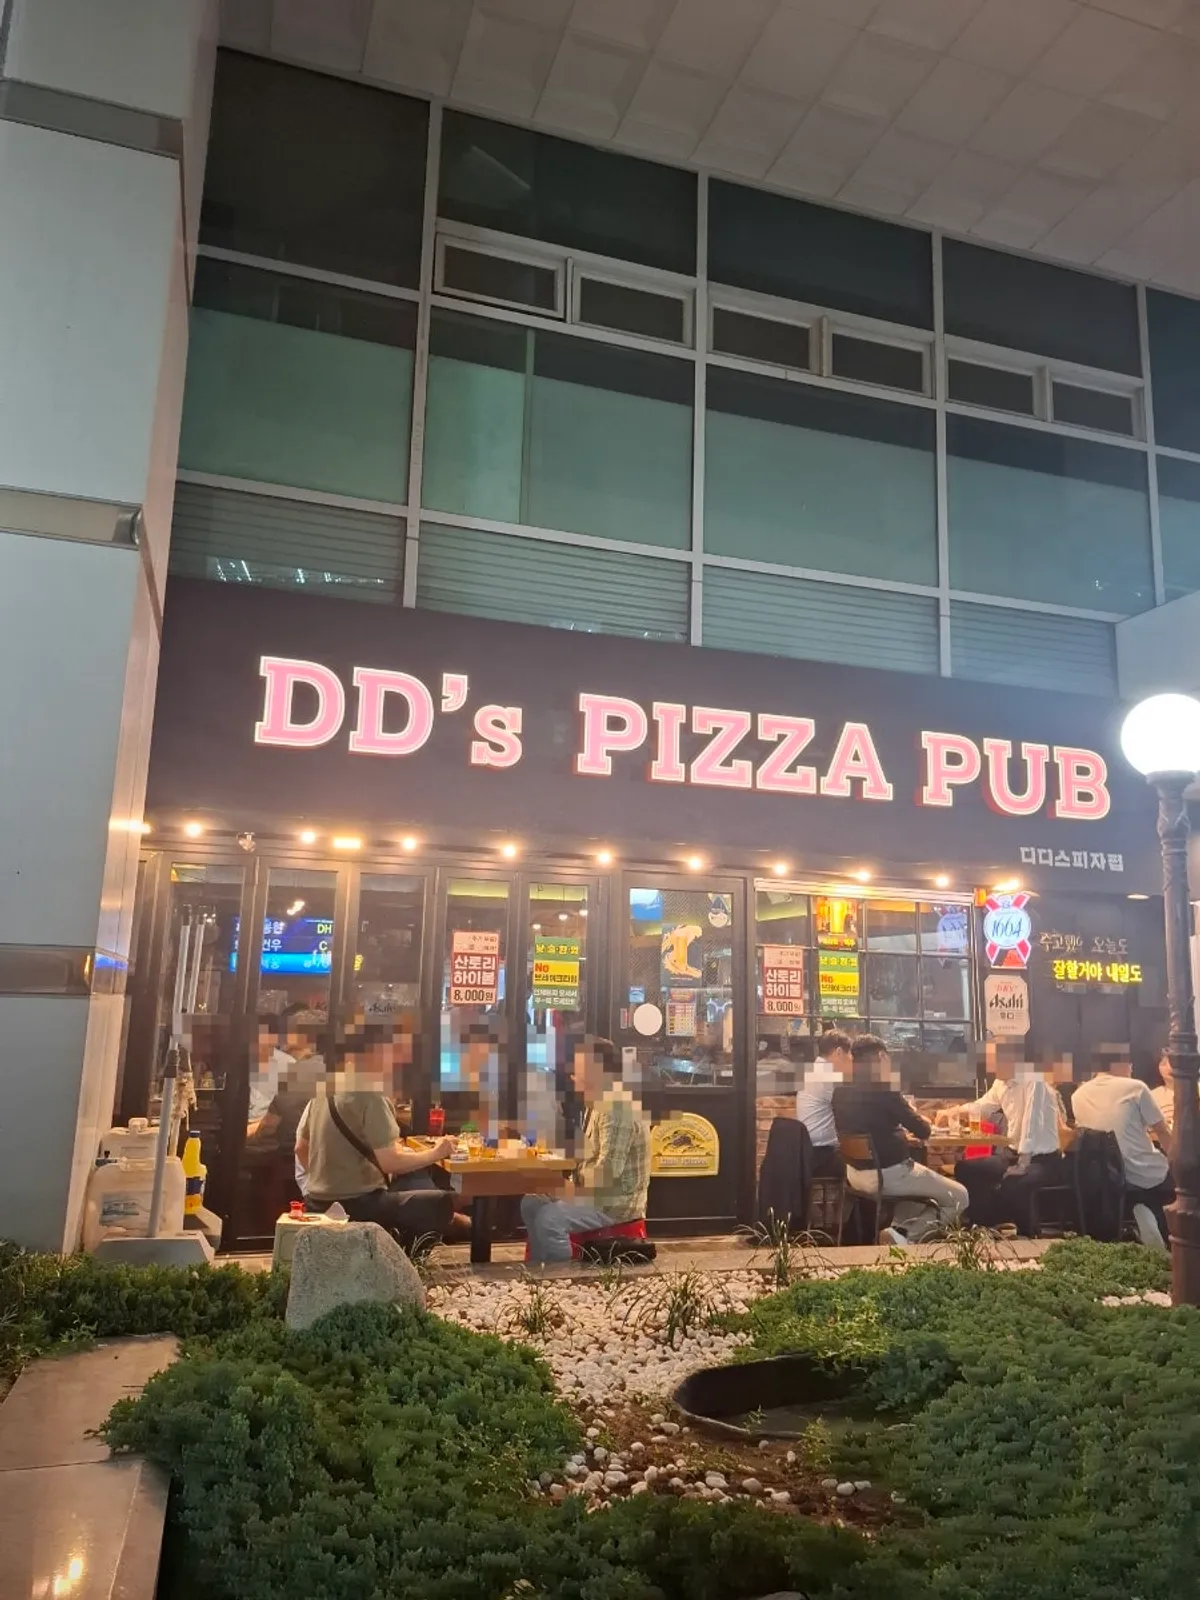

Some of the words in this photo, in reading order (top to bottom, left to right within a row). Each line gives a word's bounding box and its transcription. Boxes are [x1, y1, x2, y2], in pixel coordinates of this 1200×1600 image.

[254, 655, 523, 768] DD's
[575, 692, 893, 801] PIZZA
[918, 729, 1112, 820] PUB
[1020, 846, 1123, 872] 디디스피자펍
[317, 923, 332, 935] DH
[992, 914, 1022, 938] 1664
[454, 955, 496, 970] 산토리
[534, 962, 549, 973] No
[453, 970, 495, 986] 하이볼
[765, 968, 801, 984] 산토리
[821, 974, 833, 984] No
[1053, 959, 1102, 981] 잘할거야
[1106, 962, 1143, 983] 내일도
[765, 983, 801, 998] 하이볼
[989, 993, 1024, 1010] Asahi
